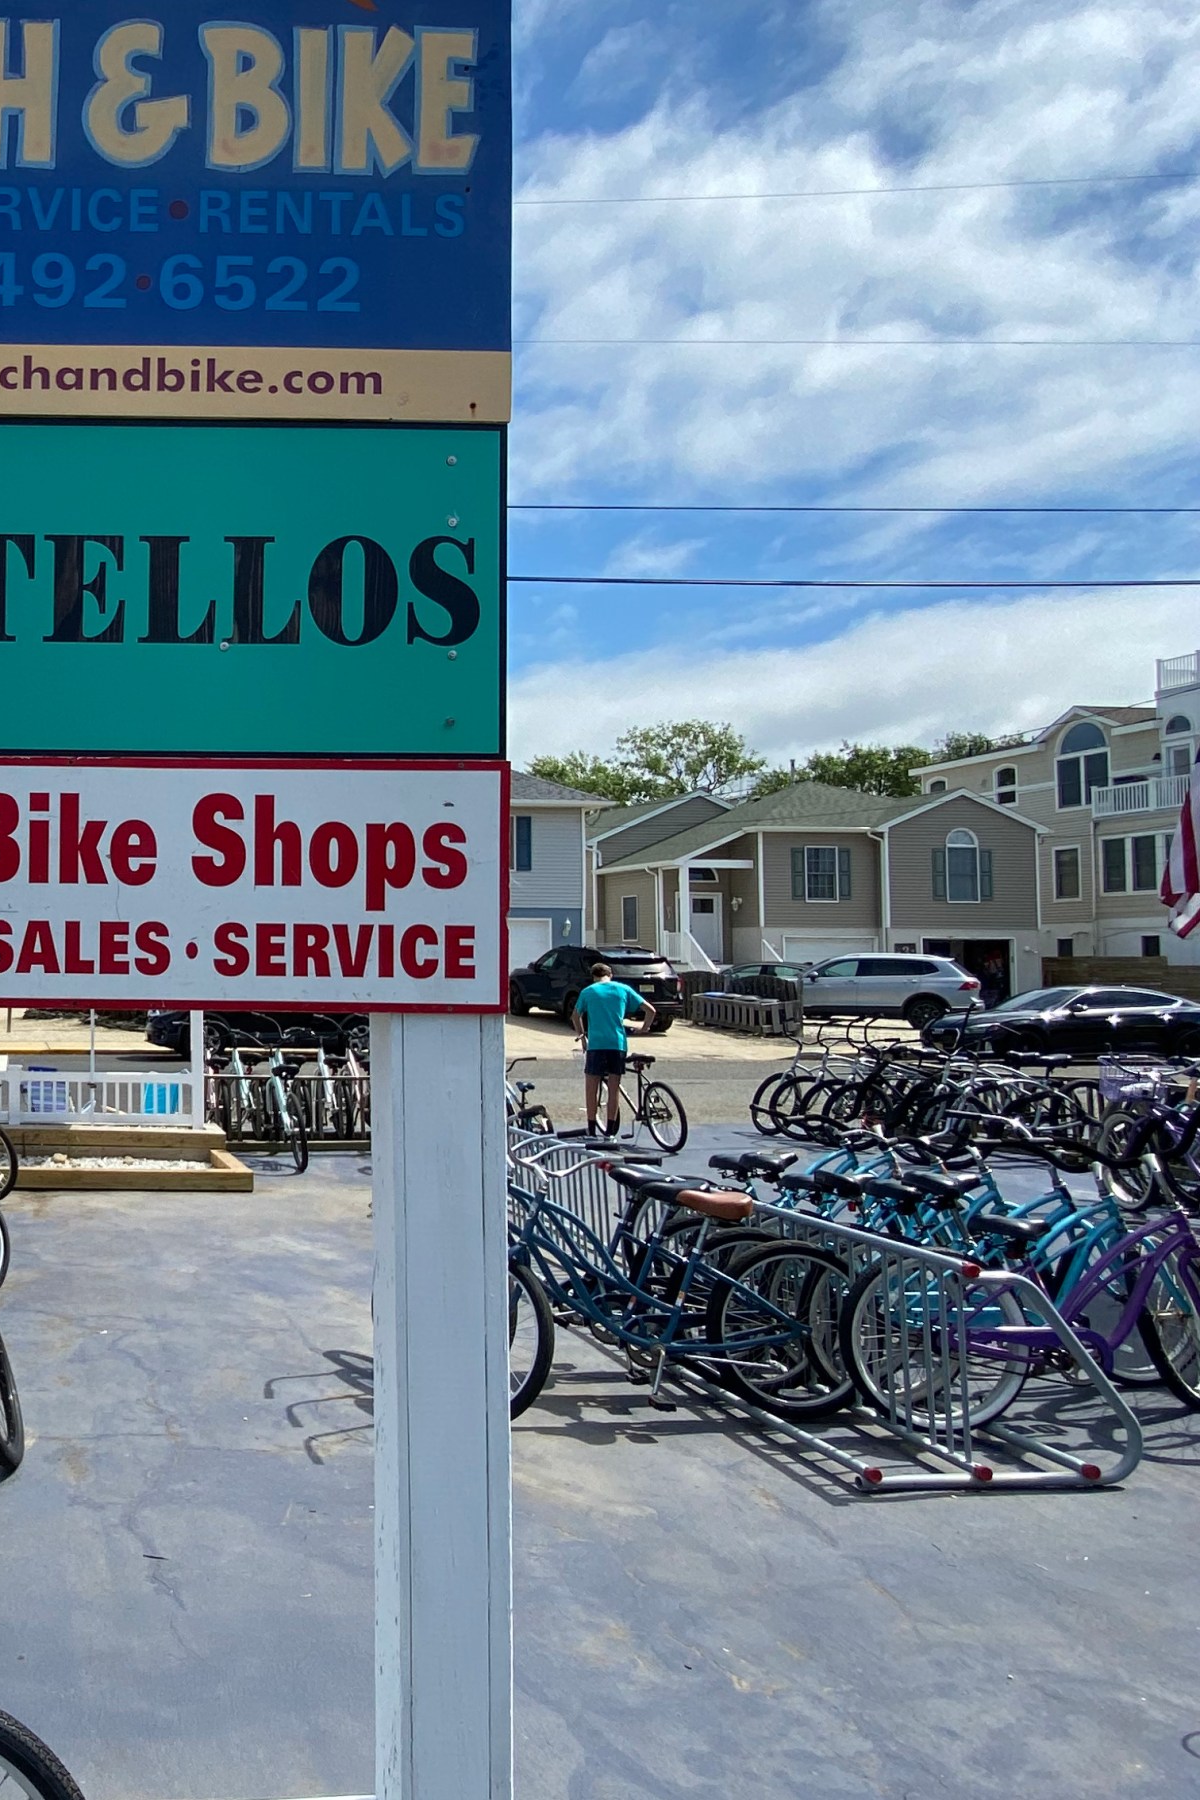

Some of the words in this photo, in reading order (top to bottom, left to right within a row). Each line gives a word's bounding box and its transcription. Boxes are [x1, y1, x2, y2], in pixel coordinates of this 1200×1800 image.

[82, 19, 193, 170] &
[199, 21, 481, 177] BIKE
[199, 191, 465, 238] RENTALS
[191, 793, 468, 911] Shops
[213, 922, 476, 979] SERVICE
